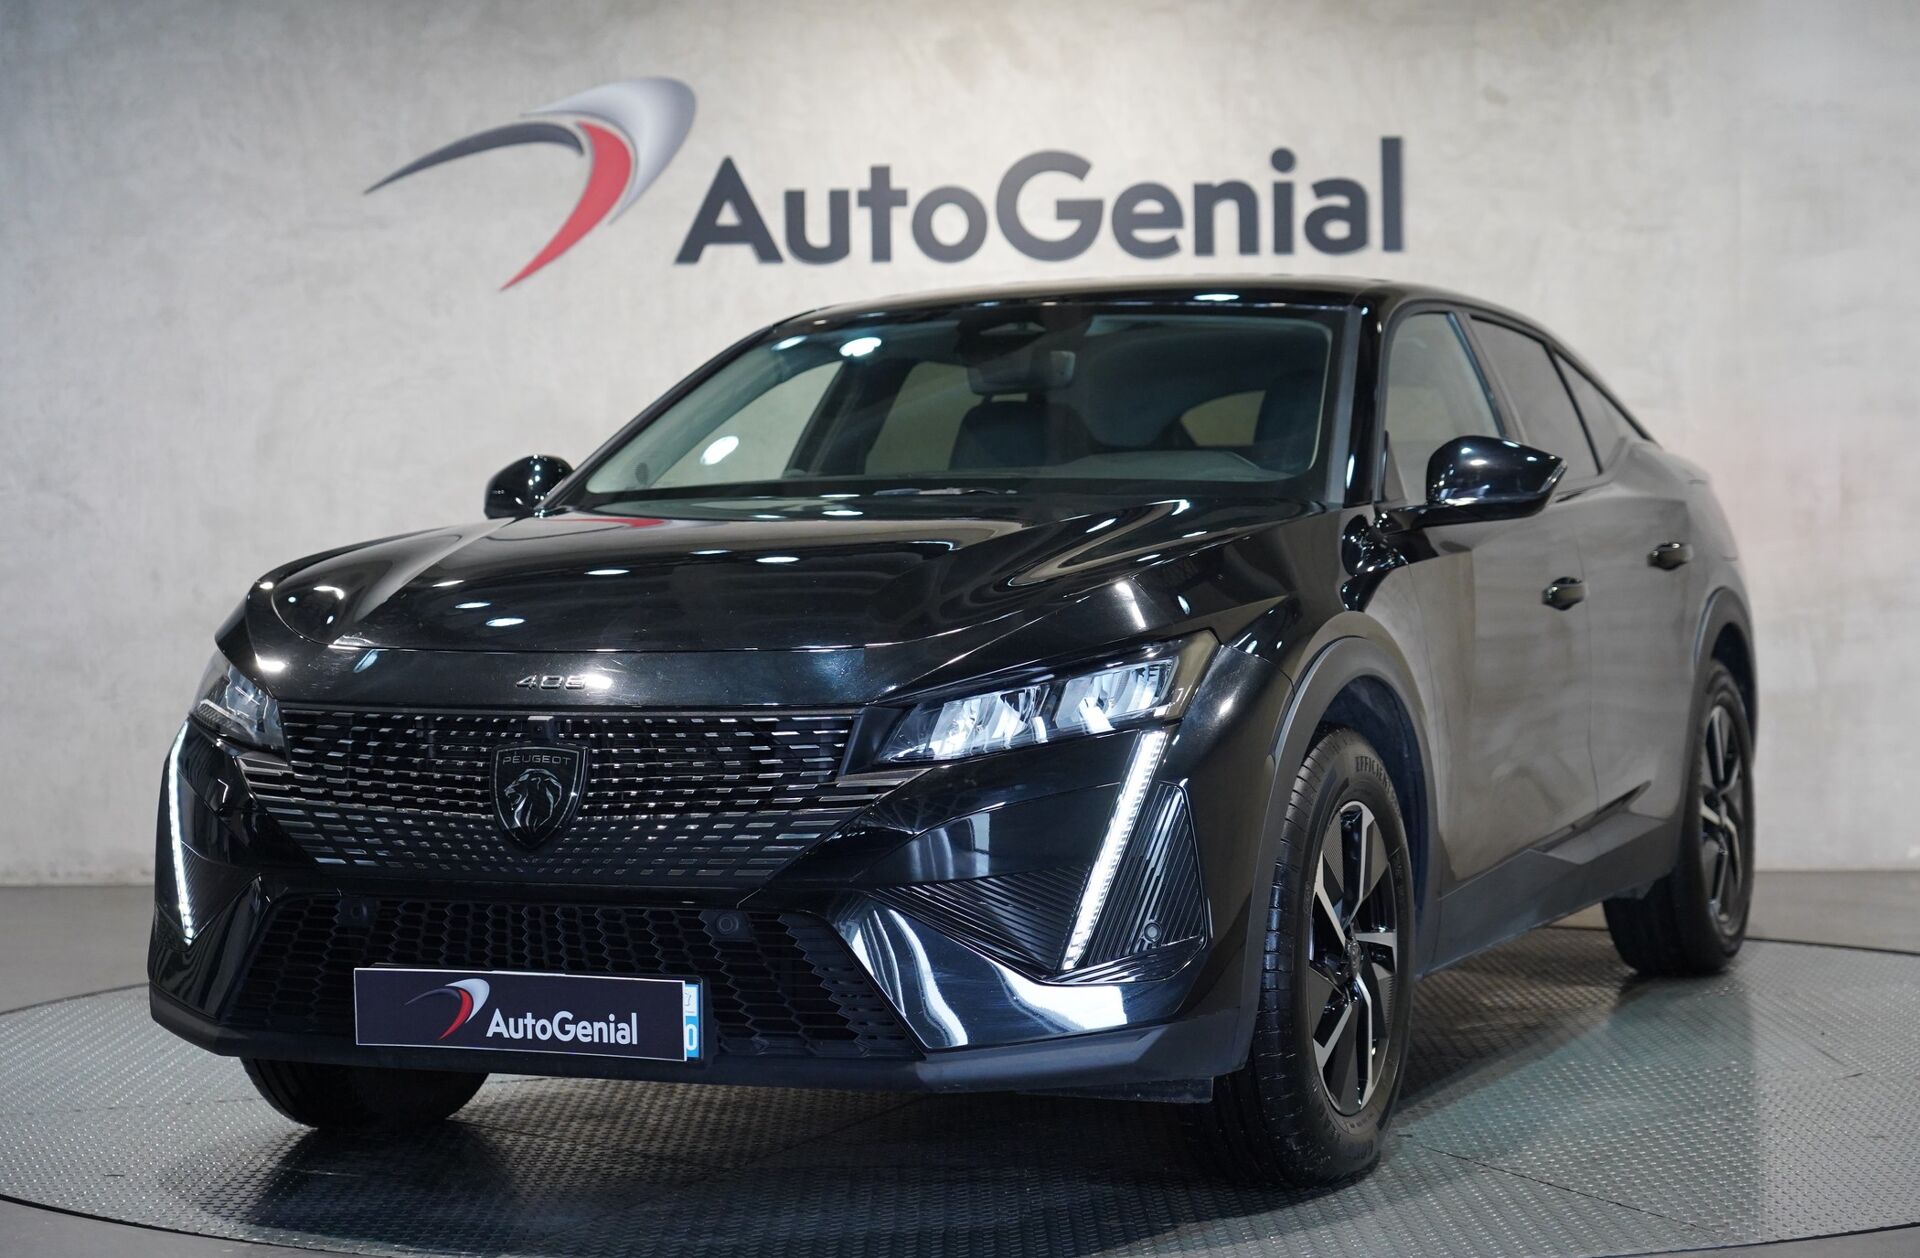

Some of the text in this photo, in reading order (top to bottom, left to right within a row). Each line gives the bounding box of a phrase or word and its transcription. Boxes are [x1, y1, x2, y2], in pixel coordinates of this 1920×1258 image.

[674, 137, 1404, 263] AutoGenial
[503, 755, 572, 765] PEUGEOT
[486, 1008, 639, 1045] AutoGenial
